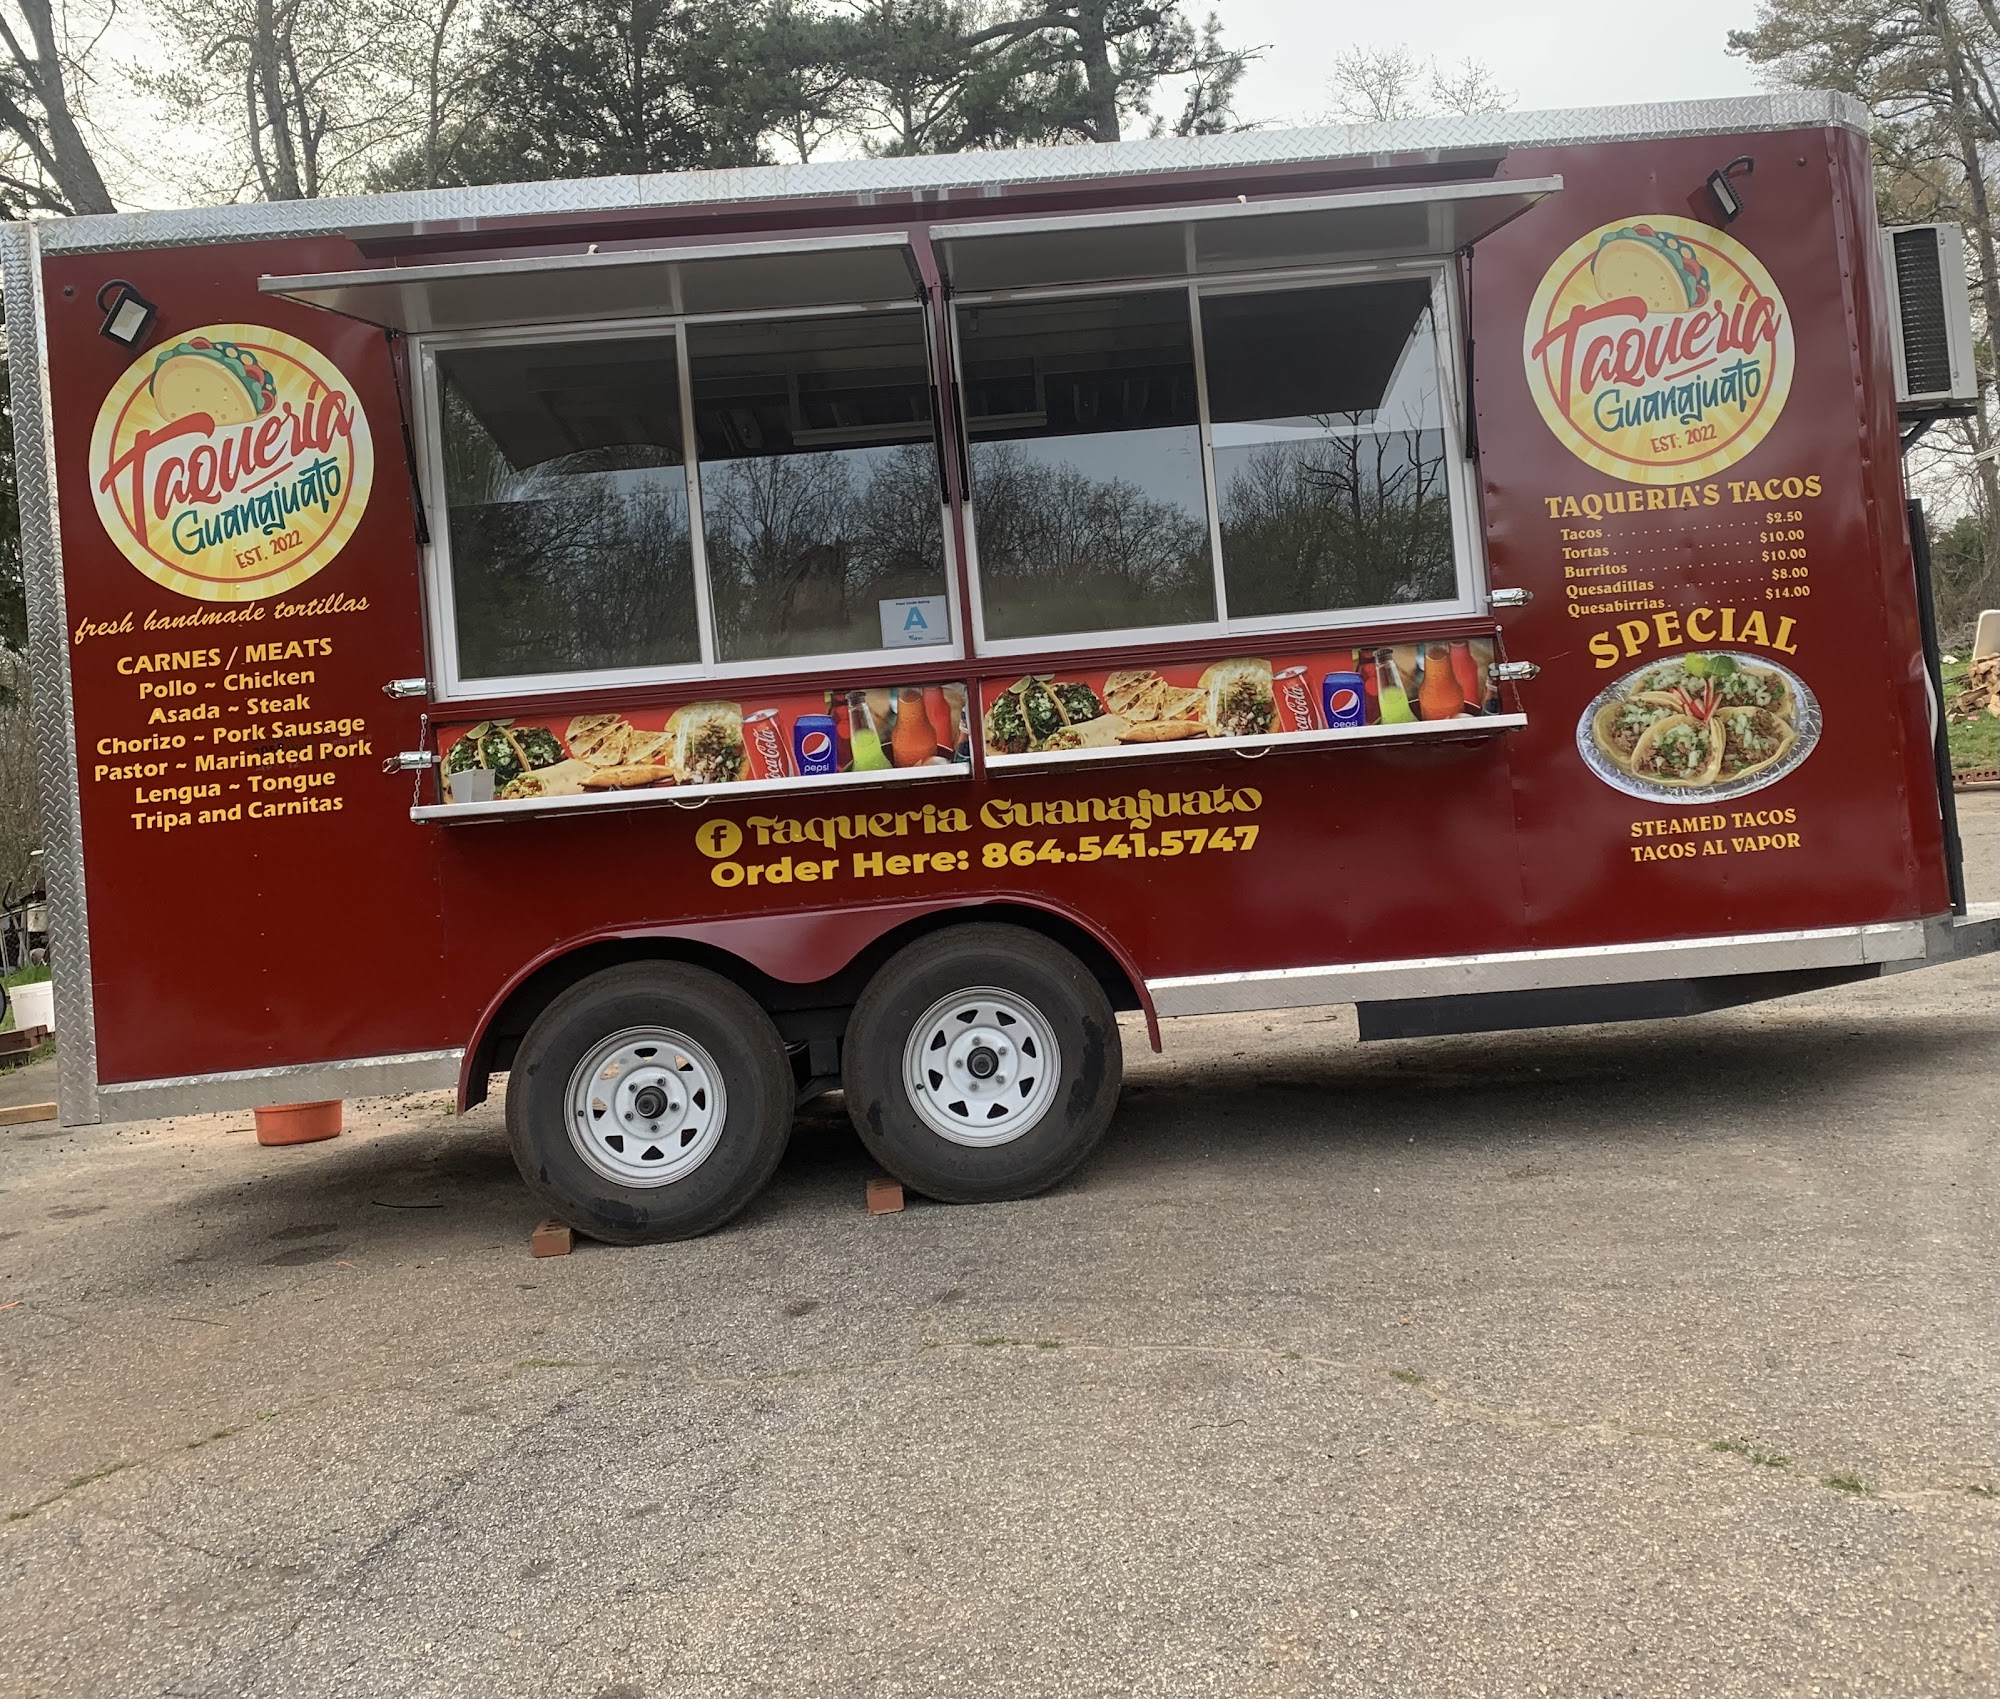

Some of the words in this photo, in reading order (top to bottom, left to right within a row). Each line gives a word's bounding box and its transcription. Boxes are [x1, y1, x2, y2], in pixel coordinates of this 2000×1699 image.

[1594, 358, 1761, 432] Guanajuato
[1684, 423, 1717, 444] 2022
[172, 457, 341, 556] Guanajuato
[1545, 482, 1720, 520] TAQUERIA'S
[1728, 475, 1822, 504] TACOS
[1561, 527, 1602, 541] Tacos
[1766, 511, 1803, 524] $2.50
[235, 547, 268, 569] EST.
[269, 530, 303, 556] 2022
[1562, 545, 1609, 560] Tortas
[1760, 529, 1805, 544] $10.00
[1564, 563, 1628, 579] Burritos
[1761, 548, 1807, 563] $10.00
[1566, 580, 1655, 600] Quesadillas
[1771, 566, 1809, 581] $8.00
[74, 611, 134, 645] fresh
[143, 602, 265, 631] handmade
[273, 592, 370, 619] tortillas
[903, 606, 928, 631] A
[1567, 598, 1665, 618] Quesabirrias
[1765, 585, 1811, 600] $14.00
[1588, 607, 1798, 669] SPECIAL
[117, 647, 221, 675] CARNES
[245, 637, 333, 662] MEATS
[139, 679, 197, 699] Pollo
[223, 670, 315, 691] Chicken
[148, 704, 220, 725] Asada
[247, 694, 311, 715] Steak
[97, 733, 186, 756] Chorizo
[213, 724, 266, 744] Pork
[272, 717, 365, 739] Sausage
[94, 762, 168, 782] Pastor
[195, 744, 313, 772] Marinated
[320, 740, 373, 759] Pork
[804, 763, 829, 773] pepsi
[136, 783, 221, 805] Lengua
[247, 772, 336, 794] Tongue
[131, 811, 192, 832] Tripa
[197, 804, 241, 824] and
[247, 797, 344, 819] Carnitas
[747, 804, 971, 851] Taqueria
[979, 785, 1264, 830] Guanajuato
[1630, 815, 1727, 838] STEAMED
[1731, 808, 1797, 829] TACOS
[710, 857, 840, 888] Order
[852, 850, 970, 878] Here:
[982, 825, 1260, 868] 864.541.5747
[1631, 842, 1697, 862] TACOS
[1702, 839, 1727, 856] AL
[1731, 832, 1802, 853] VAPOR
